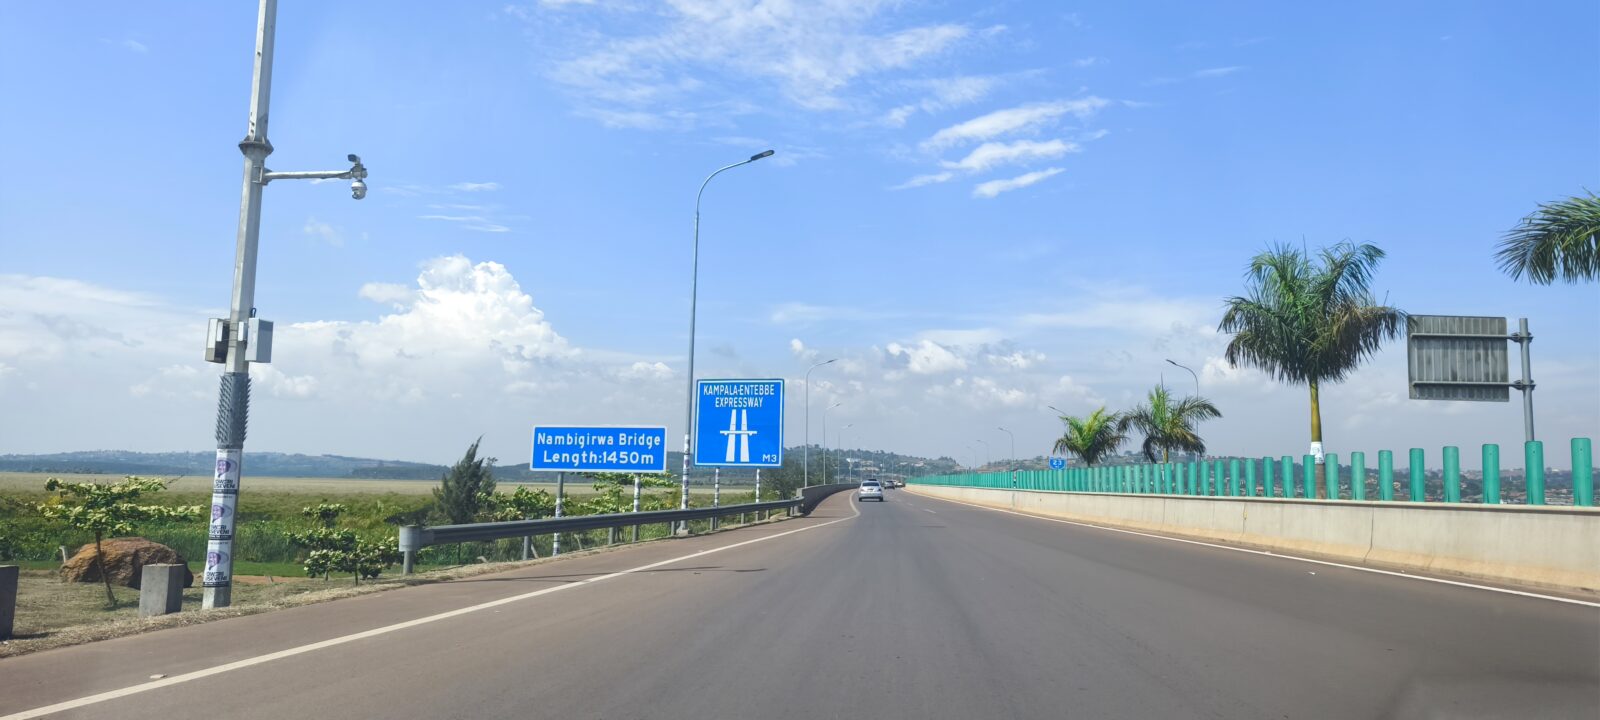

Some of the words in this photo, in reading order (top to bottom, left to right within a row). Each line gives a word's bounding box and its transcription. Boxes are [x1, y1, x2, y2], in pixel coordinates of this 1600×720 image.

[703, 384, 775, 396] KAMPALA-ENTEBBE
[715, 397, 764, 408] EXPRESSWAY
[537, 433, 614, 449] Nambigirwa
[619, 433, 661, 449] Bridge
[543, 450, 654, 467] Length:1450m
[762, 454, 777, 463] M3
